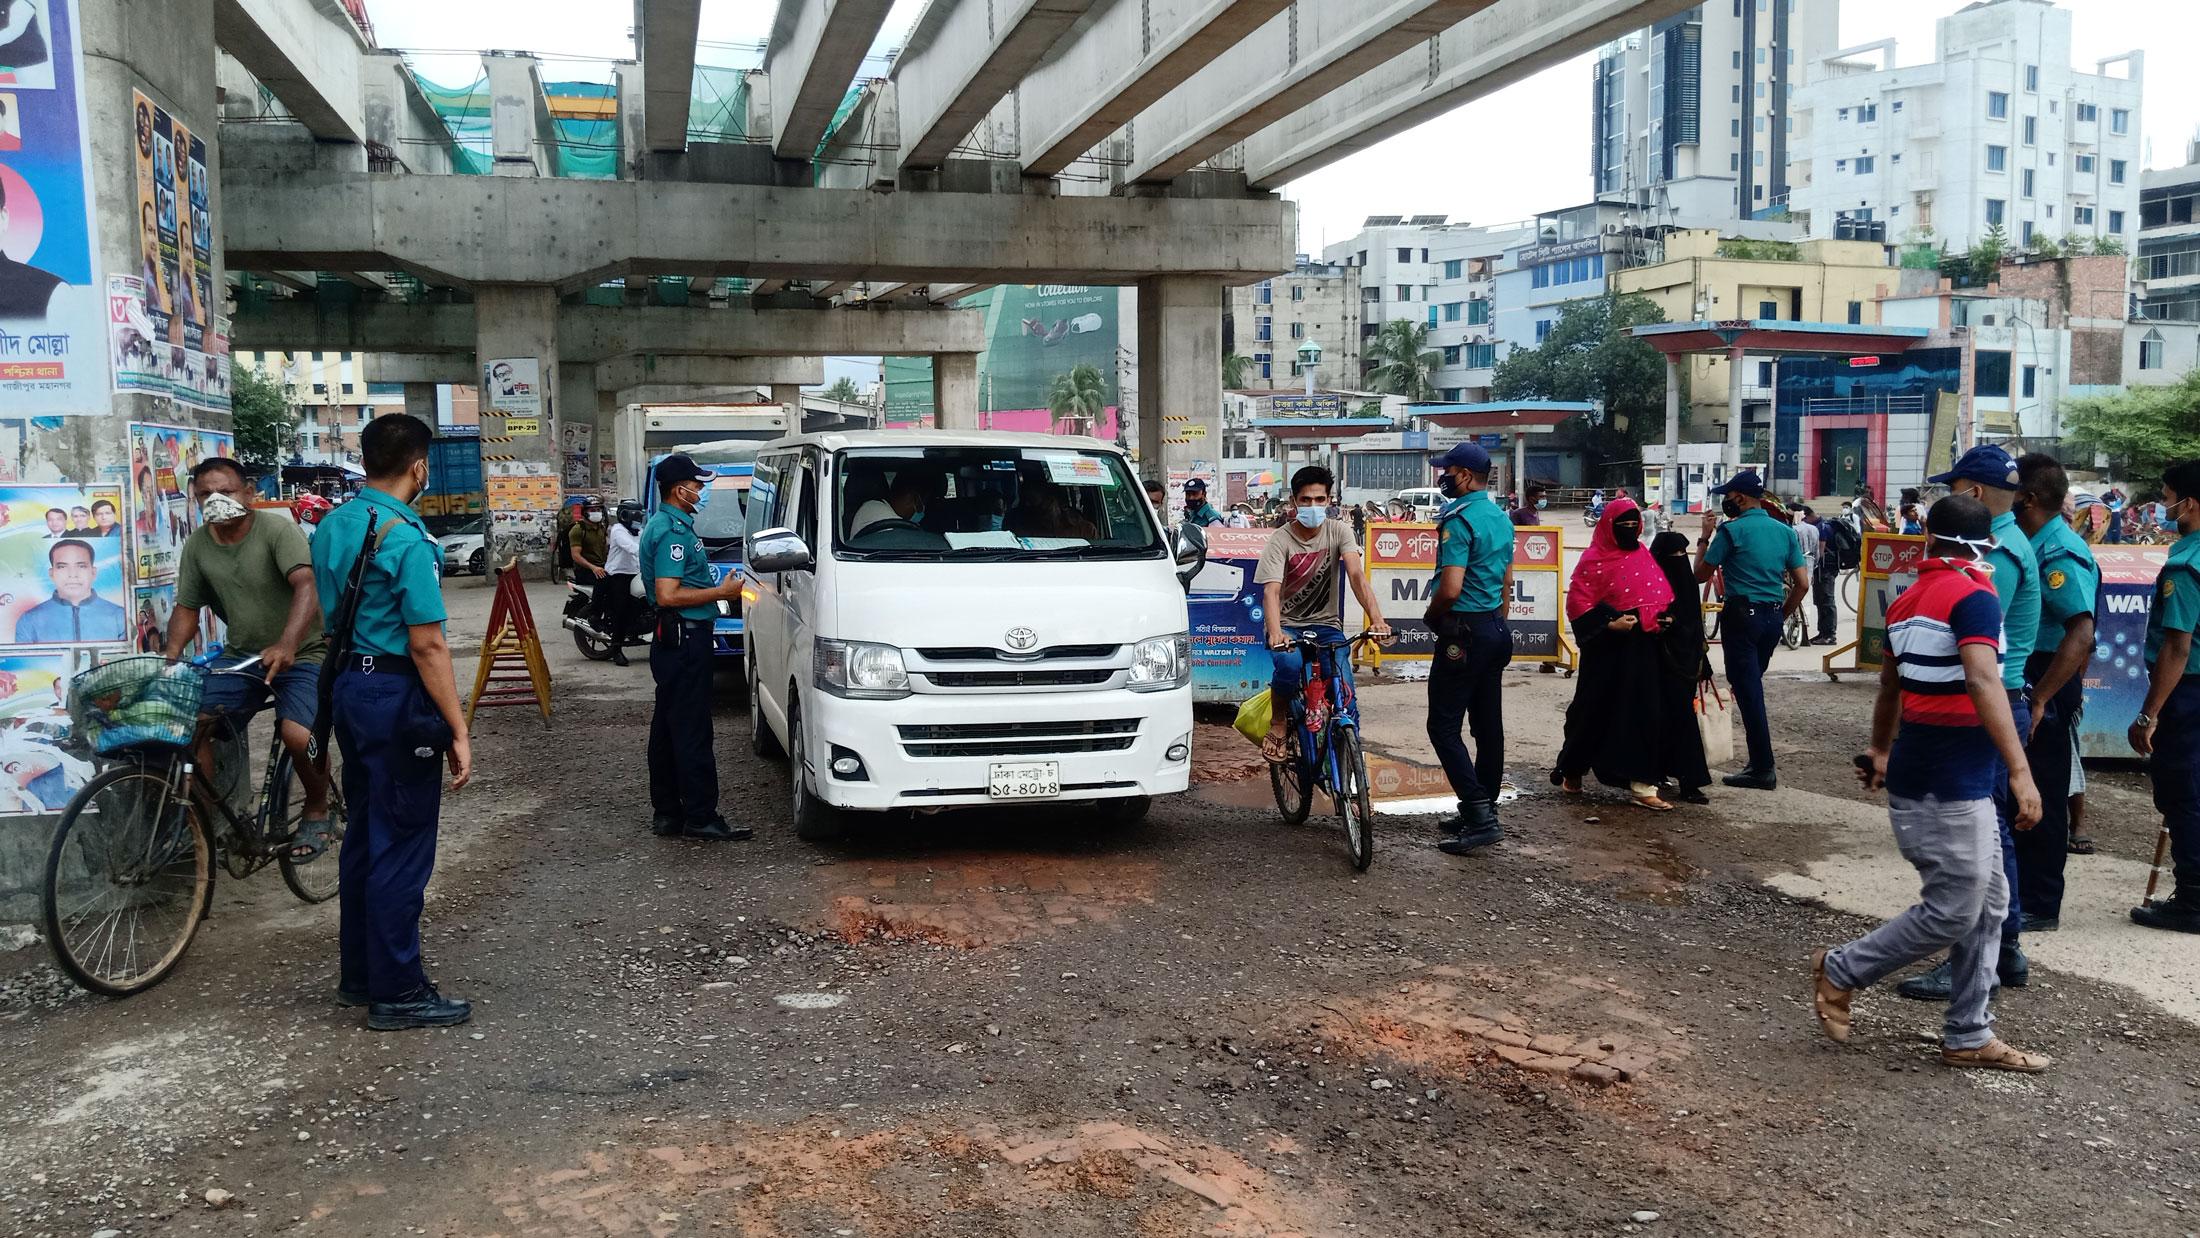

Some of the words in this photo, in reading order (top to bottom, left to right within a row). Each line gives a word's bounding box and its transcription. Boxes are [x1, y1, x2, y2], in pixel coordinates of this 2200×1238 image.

[28, 333, 70, 356] মোল্লা
[3, 365, 34, 378] পশ্চিম
[37, 367, 58, 377] থানা
[3, 381, 36, 393] গাজীপুর
[39, 382, 72, 391] মহানগর
[1377, 541, 1400, 551] STOP
[1874, 552, 1893, 562] STOP
[1400, 628, 1429, 643] ট্রাফিক
[1528, 632, 1548, 643] ঢাকা
[992, 782, 1058, 796] ১৫-৪০৮৪
